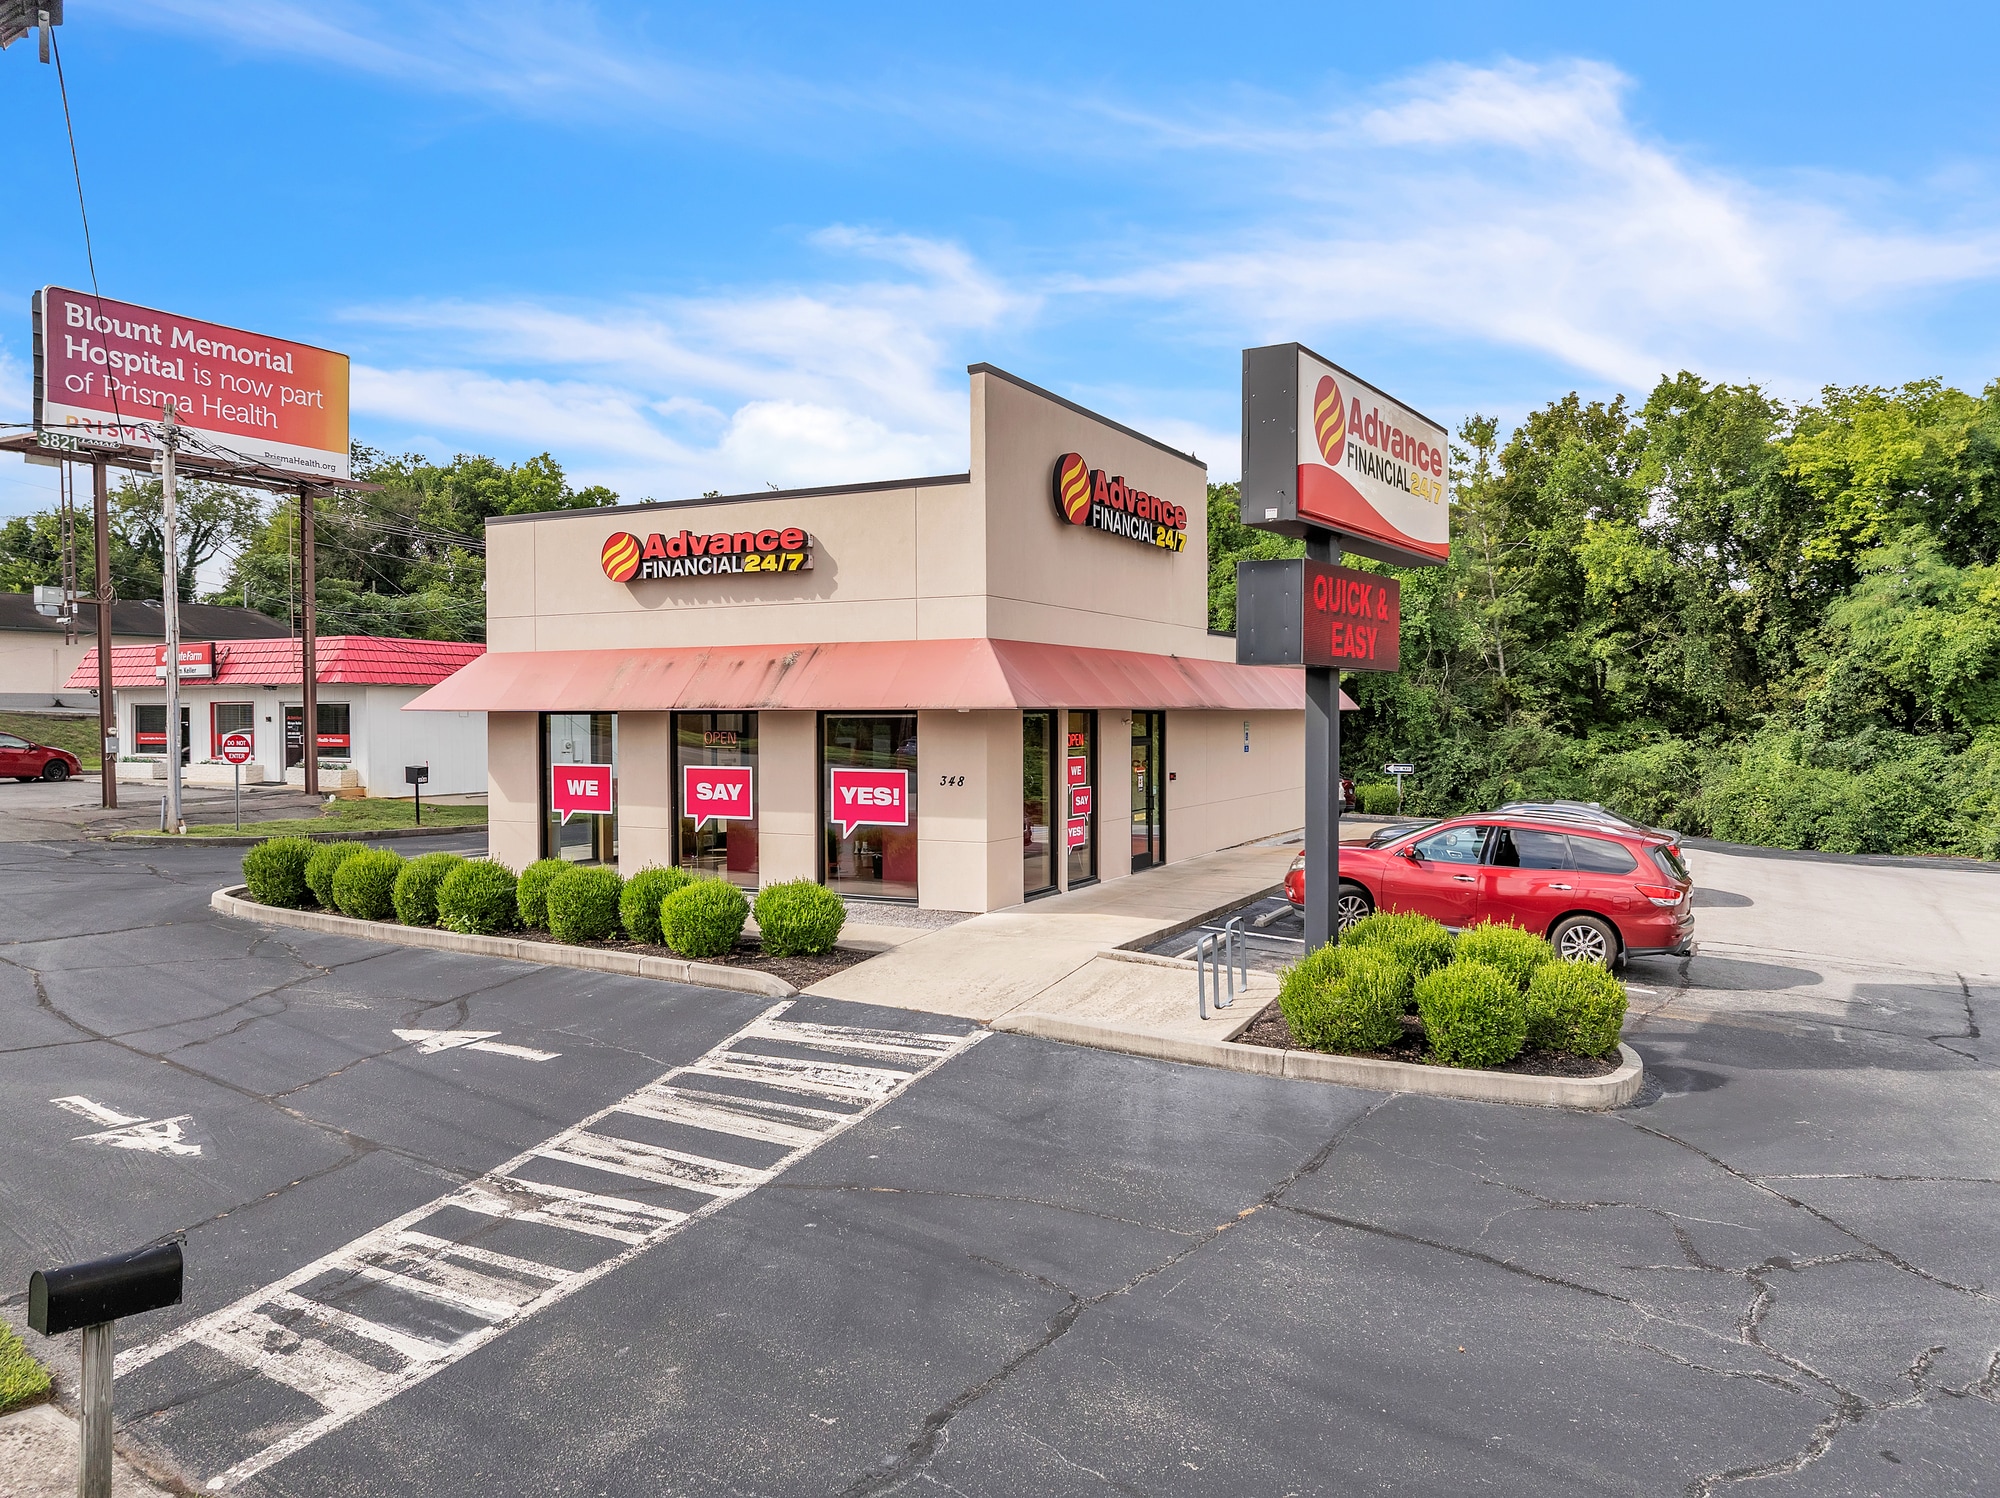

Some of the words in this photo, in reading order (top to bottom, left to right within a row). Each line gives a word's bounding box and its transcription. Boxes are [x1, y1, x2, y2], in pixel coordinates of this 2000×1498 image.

[64, 301, 162, 346] Blount
[170, 326, 294, 375] Memorial
[64, 334, 185, 381] Hospital
[193, 362, 212, 387] is
[219, 373, 274, 398] now
[280, 385, 323, 409] part
[65, 372, 94, 394] of
[102, 374, 194, 414] Prisma
[202, 394, 278, 429] Health
[39, 432, 78, 450] 3821
[1347, 397, 1442, 478] Advance
[1347, 441, 1411, 494] FINANCIAL
[1410, 472, 1442, 505] 24/7
[1092, 469, 1188, 531] Advance
[641, 527, 804, 559] Advance
[1092, 504, 1156, 545] FINANCIAL
[1156, 526, 1188, 553] 24/7
[642, 555, 744, 579] FINANCIAL
[744, 553, 804, 572] 24/7
[1313, 574, 1373, 619] QUICK
[1376, 587, 1389, 622] &
[1331, 621, 1379, 661] EASY
[704, 731, 737, 745] OPEN
[939, 775, 965, 787] 348
[1070, 765, 1082, 776] WE
[566, 779, 599, 796] WE
[696, 782, 743, 801] SAY
[839, 786, 900, 806] YES!
[1075, 795, 1089, 806] SAY
[1068, 825, 1084, 837] YES!
